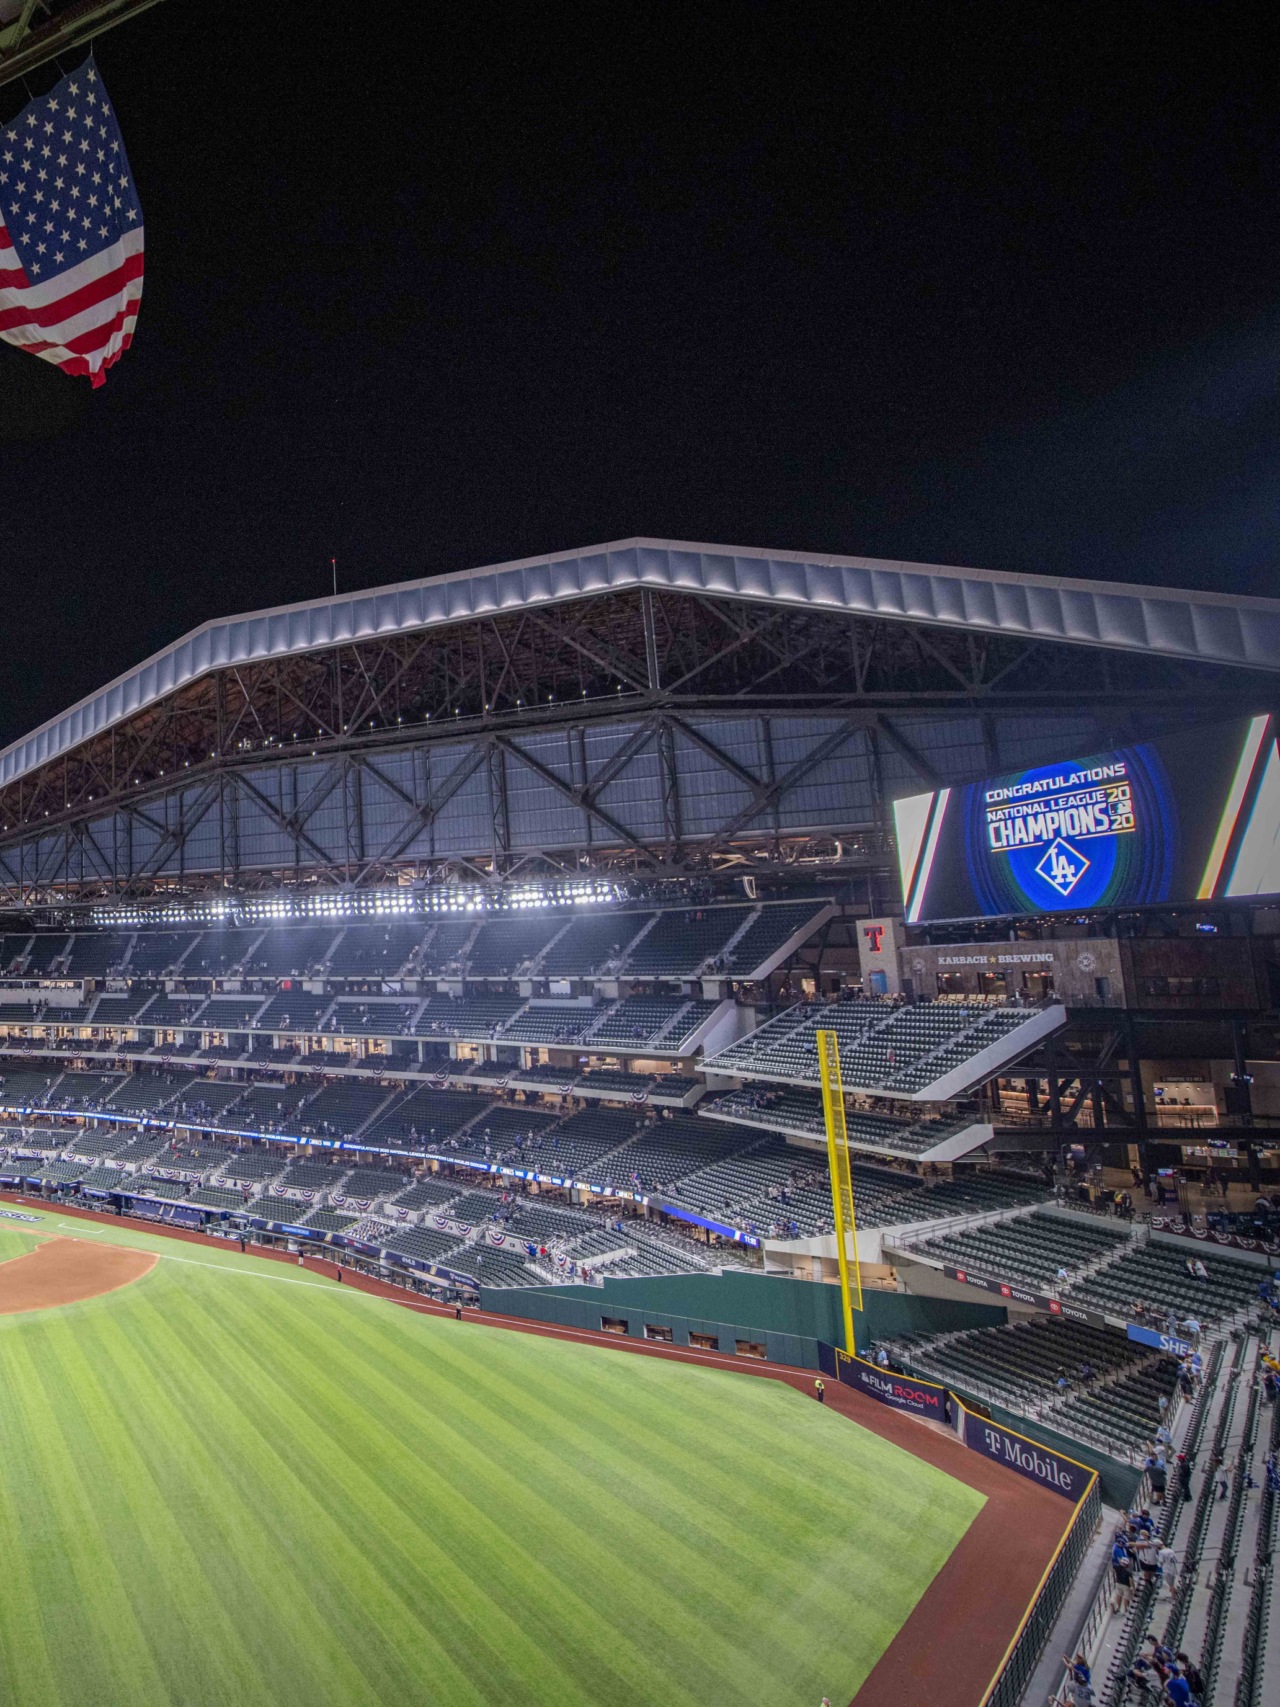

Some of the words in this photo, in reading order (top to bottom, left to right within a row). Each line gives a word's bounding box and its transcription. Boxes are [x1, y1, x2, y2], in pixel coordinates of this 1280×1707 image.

[985, 763, 1126, 802] CONGRATULATIONS
[987, 803, 1049, 822] NATIONAL
[1050, 790, 1106, 812] LEAGUE
[1106, 786, 1131, 803] 20
[989, 804, 1109, 848] CHAMPIONS
[1110, 813, 1135, 830] 20
[1050, 848, 1076, 884] LA
[864, 925, 885, 953] T
[938, 956, 988, 965] KARBACH
[998, 953, 1054, 964] BREWING
[966, 1276, 988, 1288] TOYOTA
[1012, 1290, 1035, 1303] TOYOTA
[1061, 1306, 1088, 1320] TOYOTA
[1160, 1335, 1188, 1356] SHE
[840, 1353, 851, 1364] 329
[869, 1375, 893, 1393] FILM
[894, 1385, 939, 1407] ROOM
[885, 1393, 906, 1404] Google
[907, 1399, 924, 1409] Cloud
[985, 1428, 1000, 1454] T
[1004, 1437, 1072, 1490] Mobile
